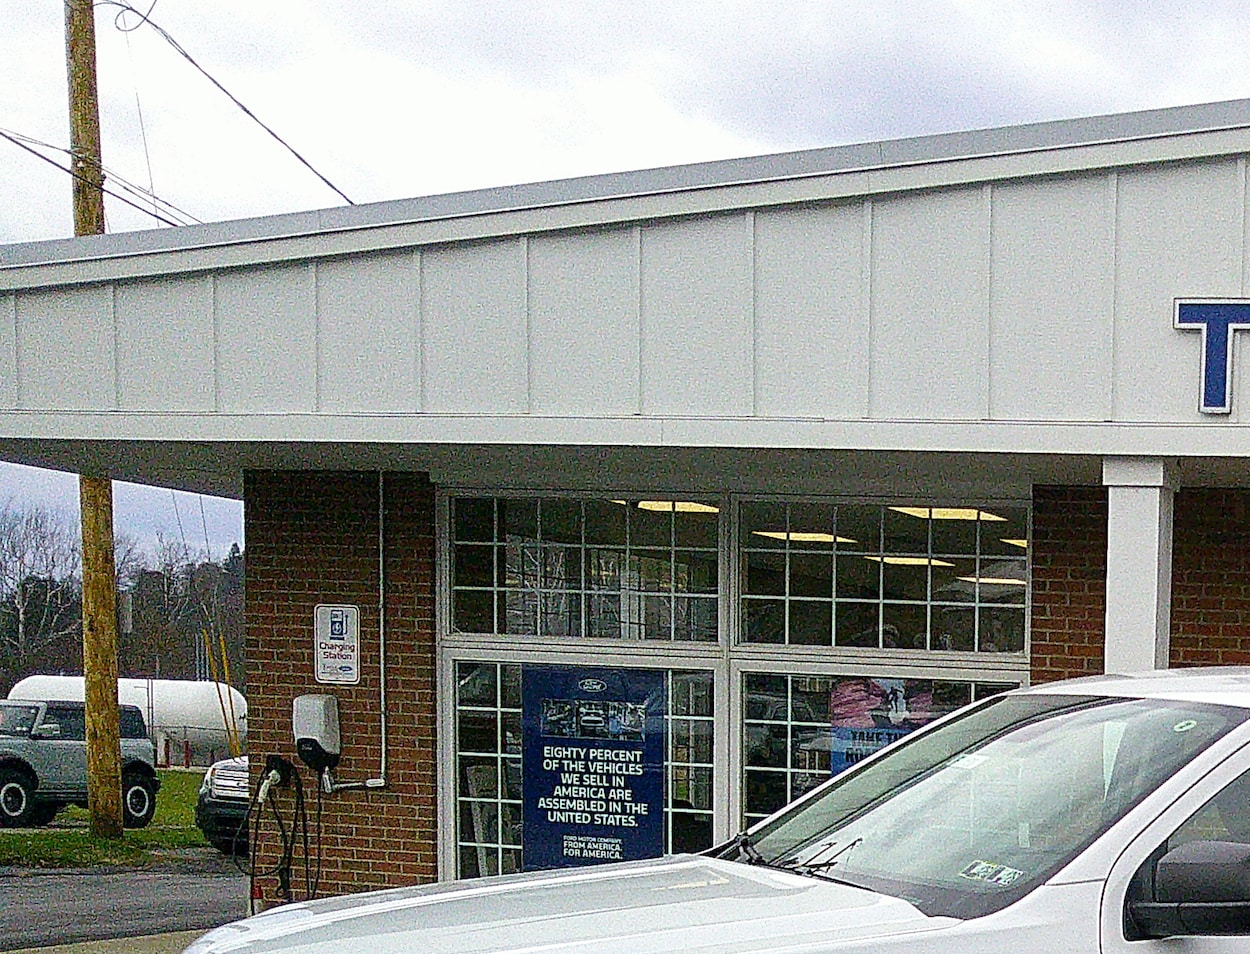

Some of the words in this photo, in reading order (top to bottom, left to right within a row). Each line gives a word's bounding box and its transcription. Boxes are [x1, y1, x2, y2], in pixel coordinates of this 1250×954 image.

[320, 641, 355, 652] Charging
[323, 651, 352, 660] Station
[543, 746, 587, 759] EIGHTY
[589, 748, 643, 762] PERCENT
[543, 759, 560, 771] OF
[562, 760, 586, 772] THE
[588, 761, 643, 775] VEHICLES
[561, 773, 580, 785] WE
[582, 774, 609, 787] SELL
[612, 775, 625, 787] IN
[553, 785, 606, 800] AMERICA
[608, 789, 632, 800] ARE
[537, 797, 606, 812] ASSEMBLED
[609, 801, 622, 813] IN
[624, 802, 649, 815] THE
[547, 811, 591, 824] UNITED
[594, 813, 639, 827] STATES.
[563, 841, 586, 849] FROM
[587, 842, 623, 852] AMERICA.
[563, 848, 581, 857] FOR
[582, 849, 623, 860] AMERICA.
